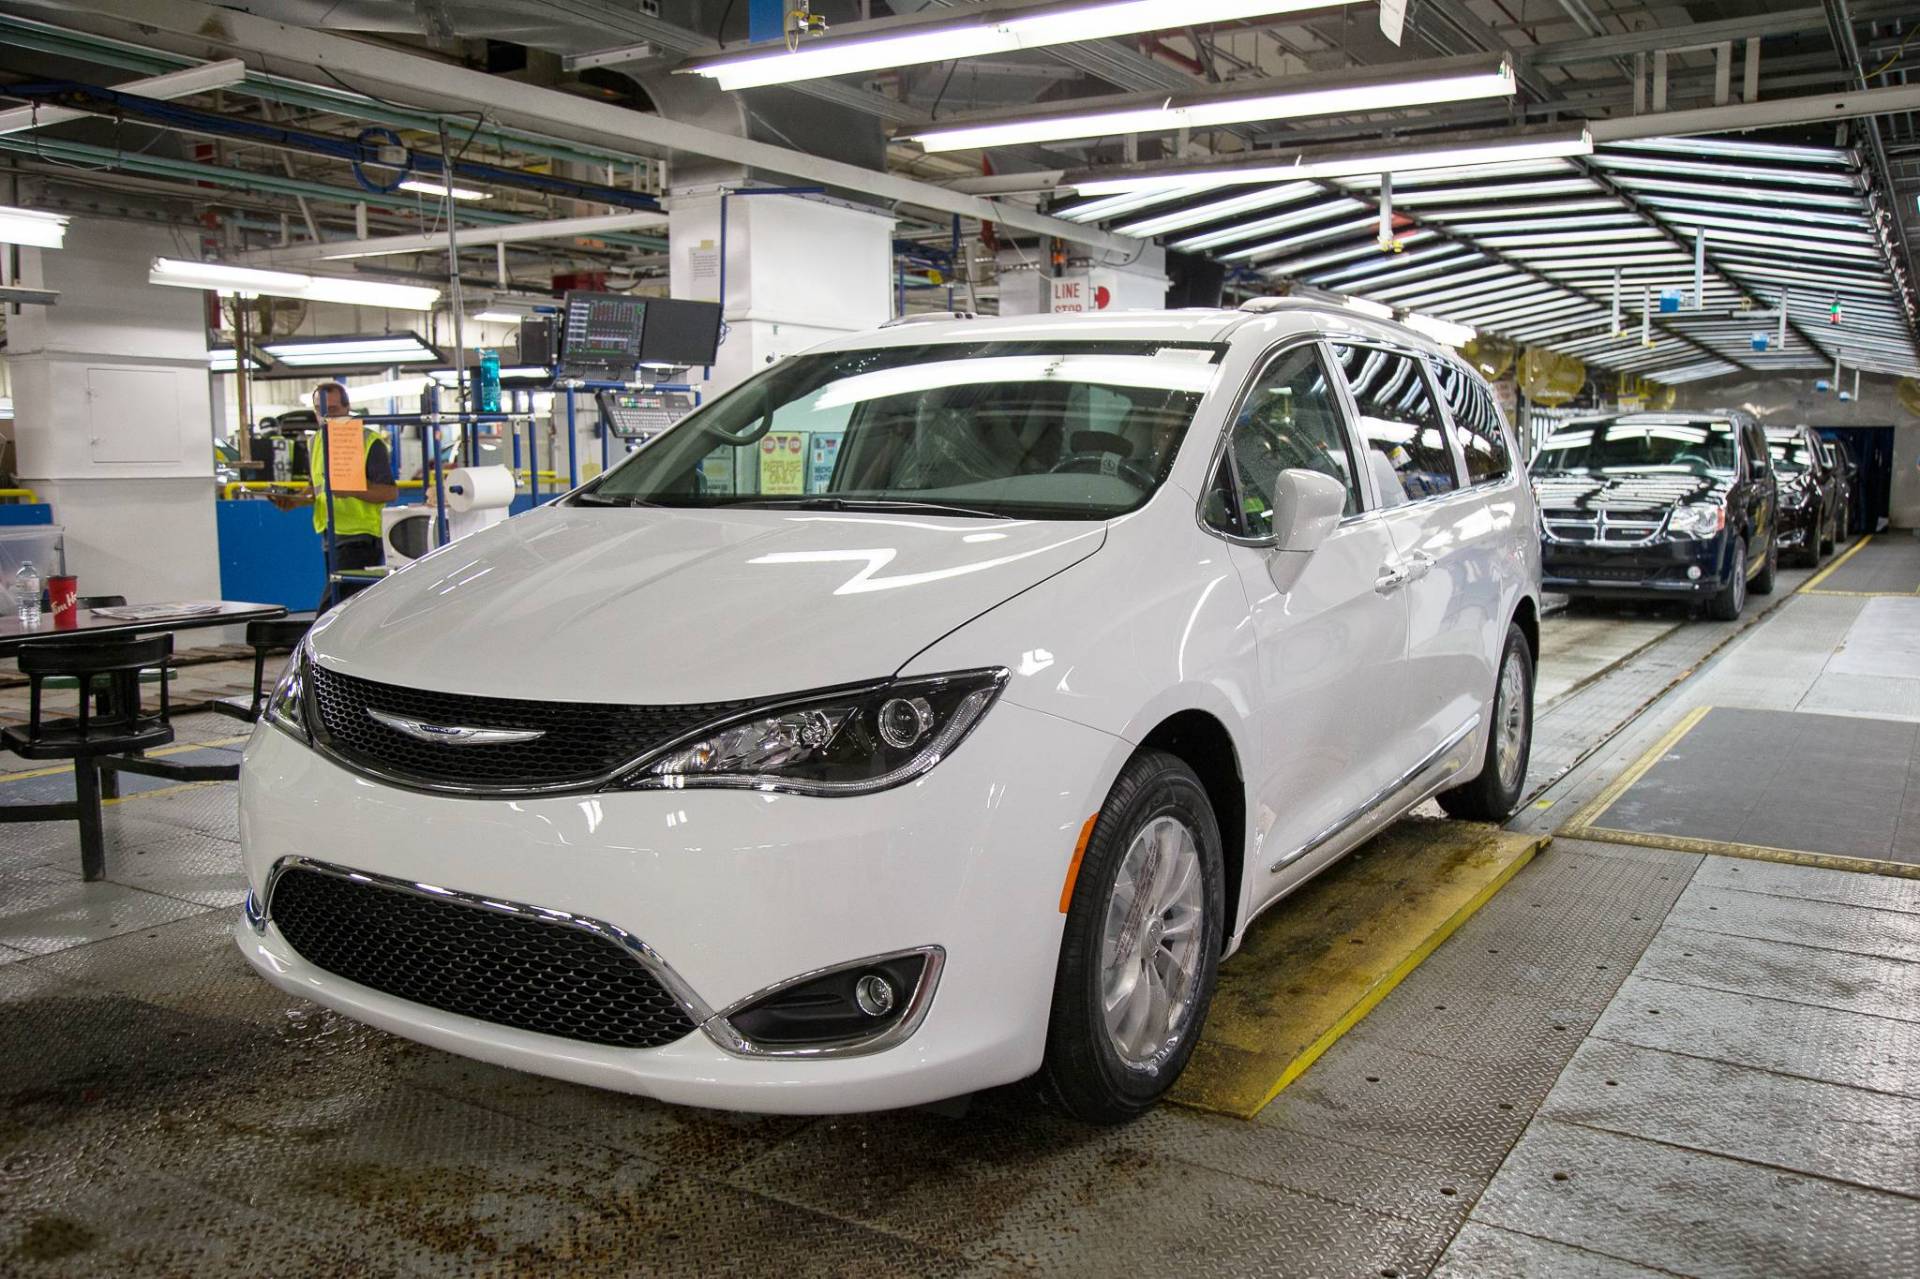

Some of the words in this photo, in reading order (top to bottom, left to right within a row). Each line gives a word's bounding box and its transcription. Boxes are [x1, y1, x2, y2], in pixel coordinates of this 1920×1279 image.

[1055, 282, 1080, 299] LINE
[763, 461, 801, 473] REFUSE
[769, 472, 796, 484] ONLY
